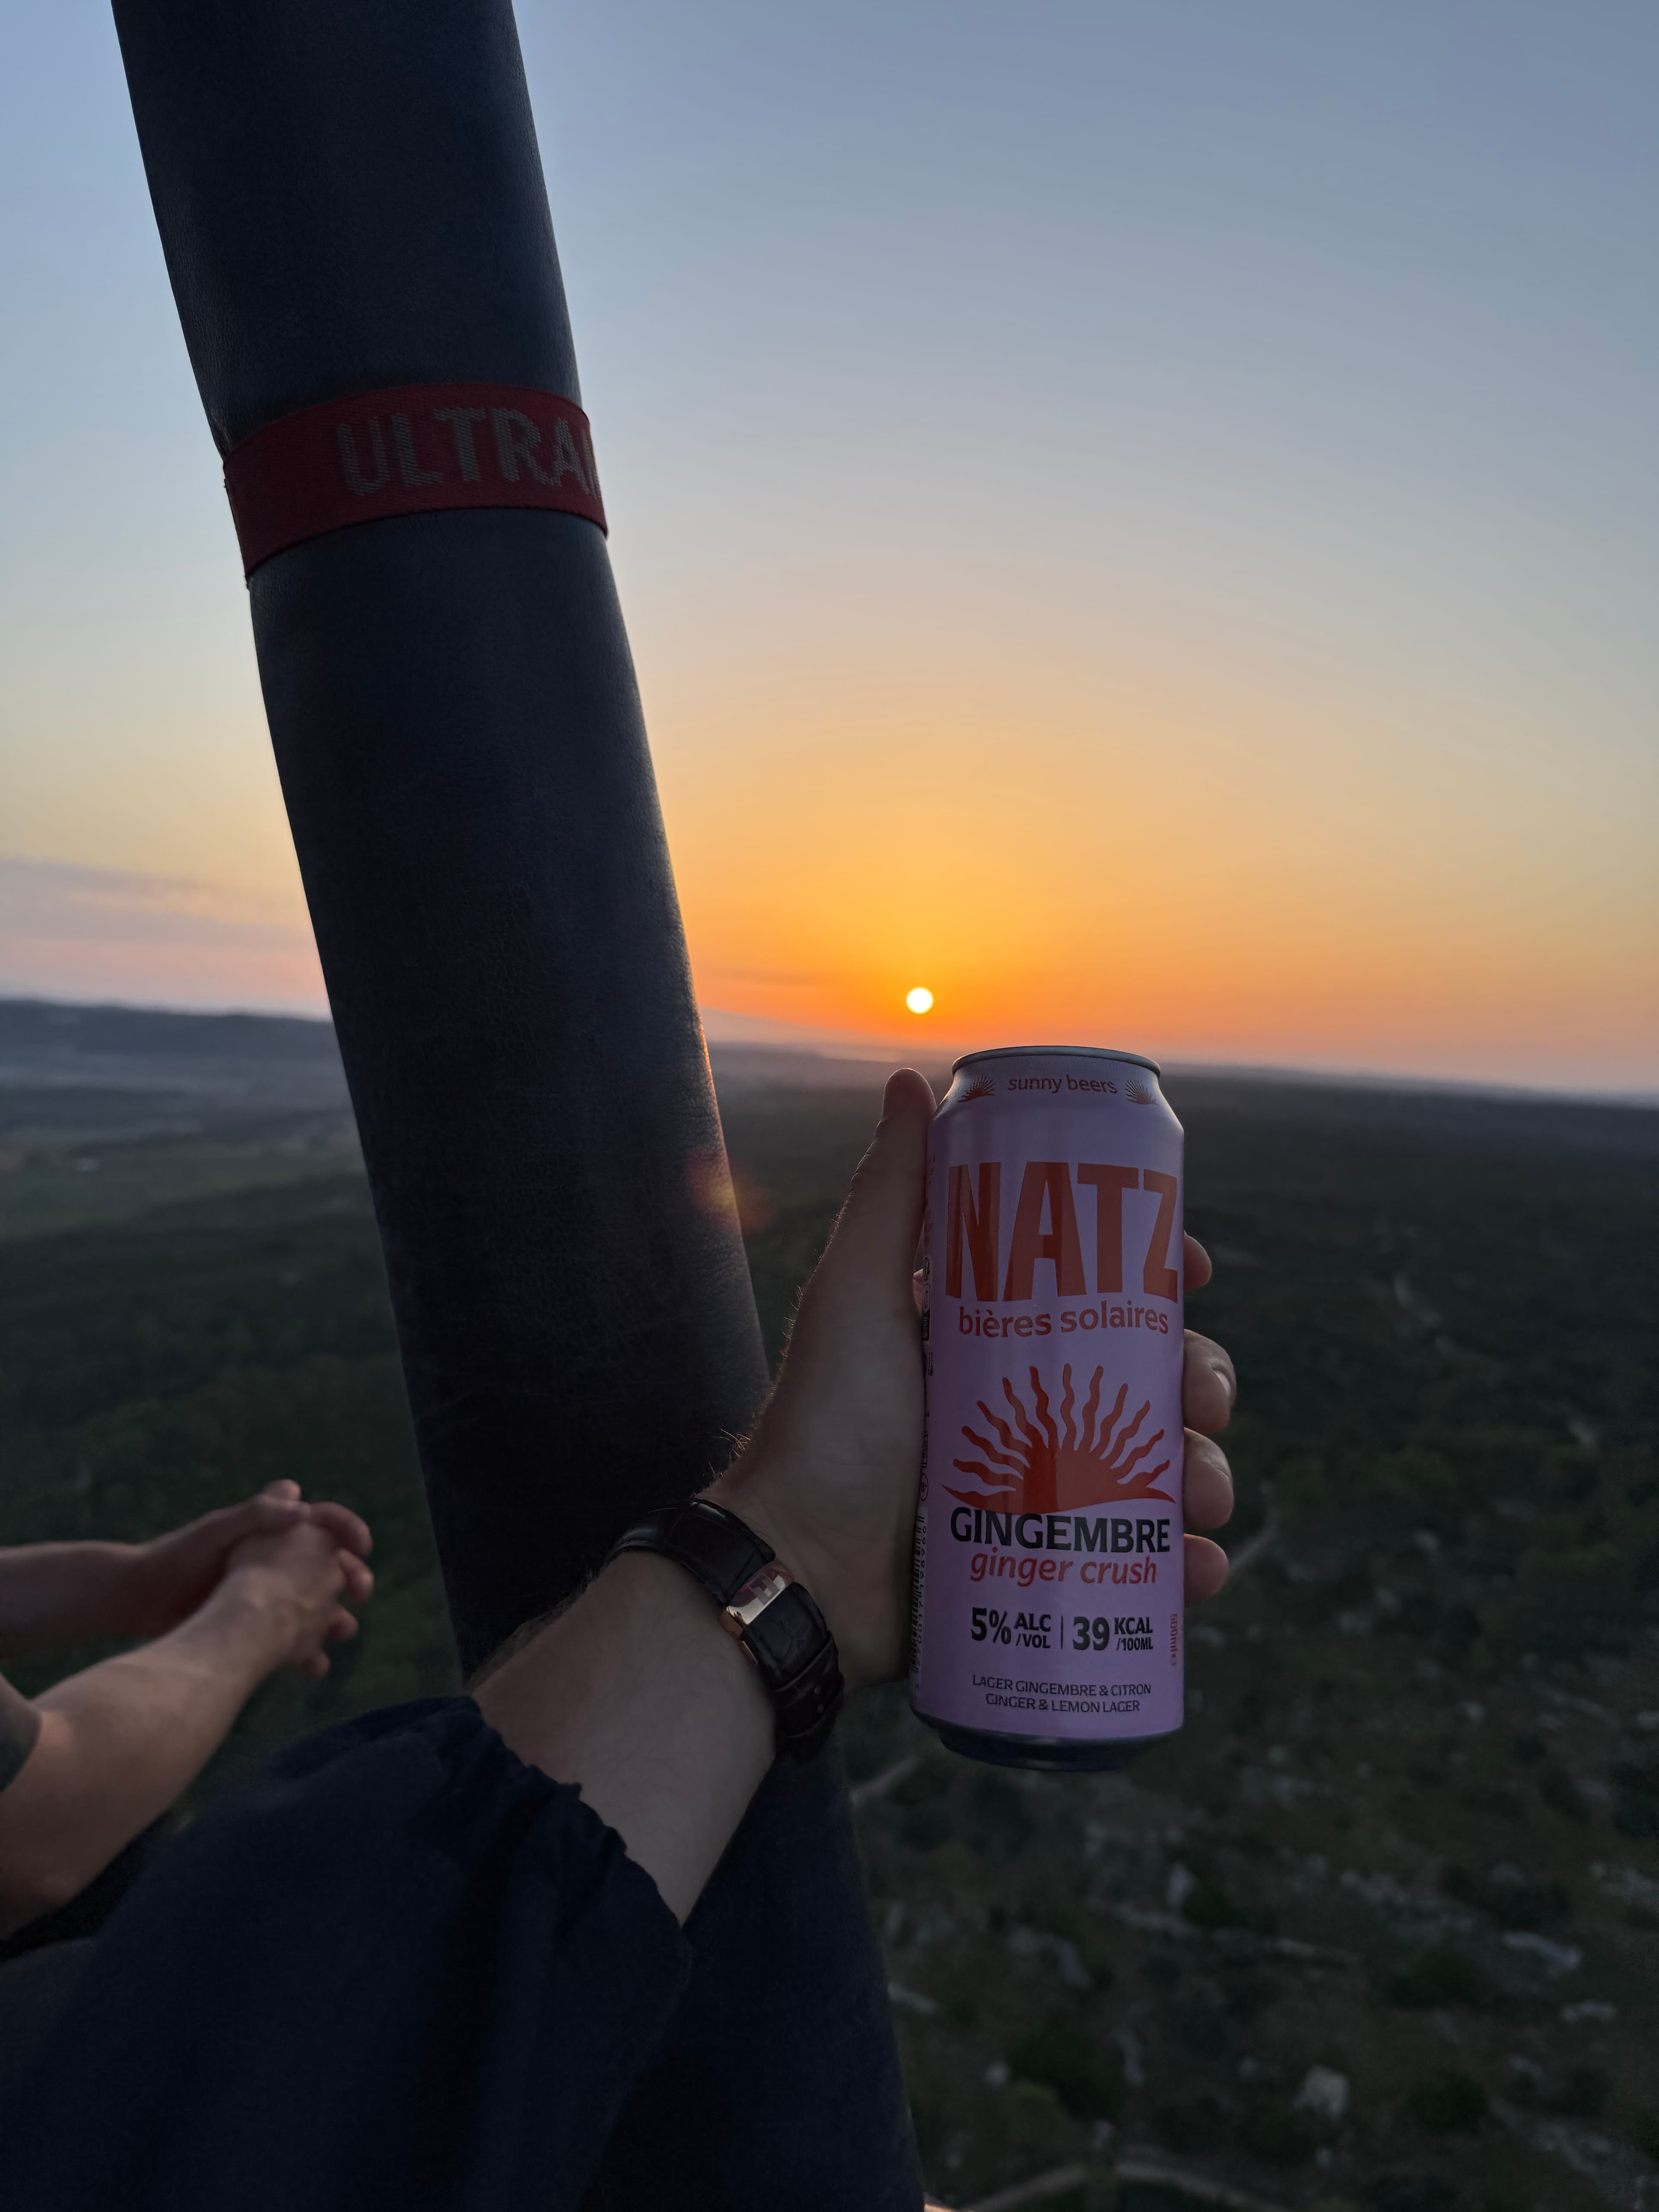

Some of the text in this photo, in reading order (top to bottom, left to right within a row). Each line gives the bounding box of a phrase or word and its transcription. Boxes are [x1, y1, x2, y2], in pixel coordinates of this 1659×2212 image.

[1007, 1075, 1117, 1093] sunny beers
[945, 1161, 1178, 1304] NATZ
[959, 1300, 1169, 1338] bières solaires
[950, 1506, 1170, 1553] GINGEMBRE
[969, 1547, 1157, 1587] ginger crush
[971, 1607, 1051, 1645] 5% ALC
[1016, 1633, 1051, 1649] /VOL
[1072, 1616, 1153, 1651] 39 KCAL
[1116, 1637, 1154, 1651] /100ML
[973, 1674, 1151, 1696] LAGER GINGEMBRE & CITRON
[985, 1693, 1140, 1713] GINGER & LEMON LAGER
